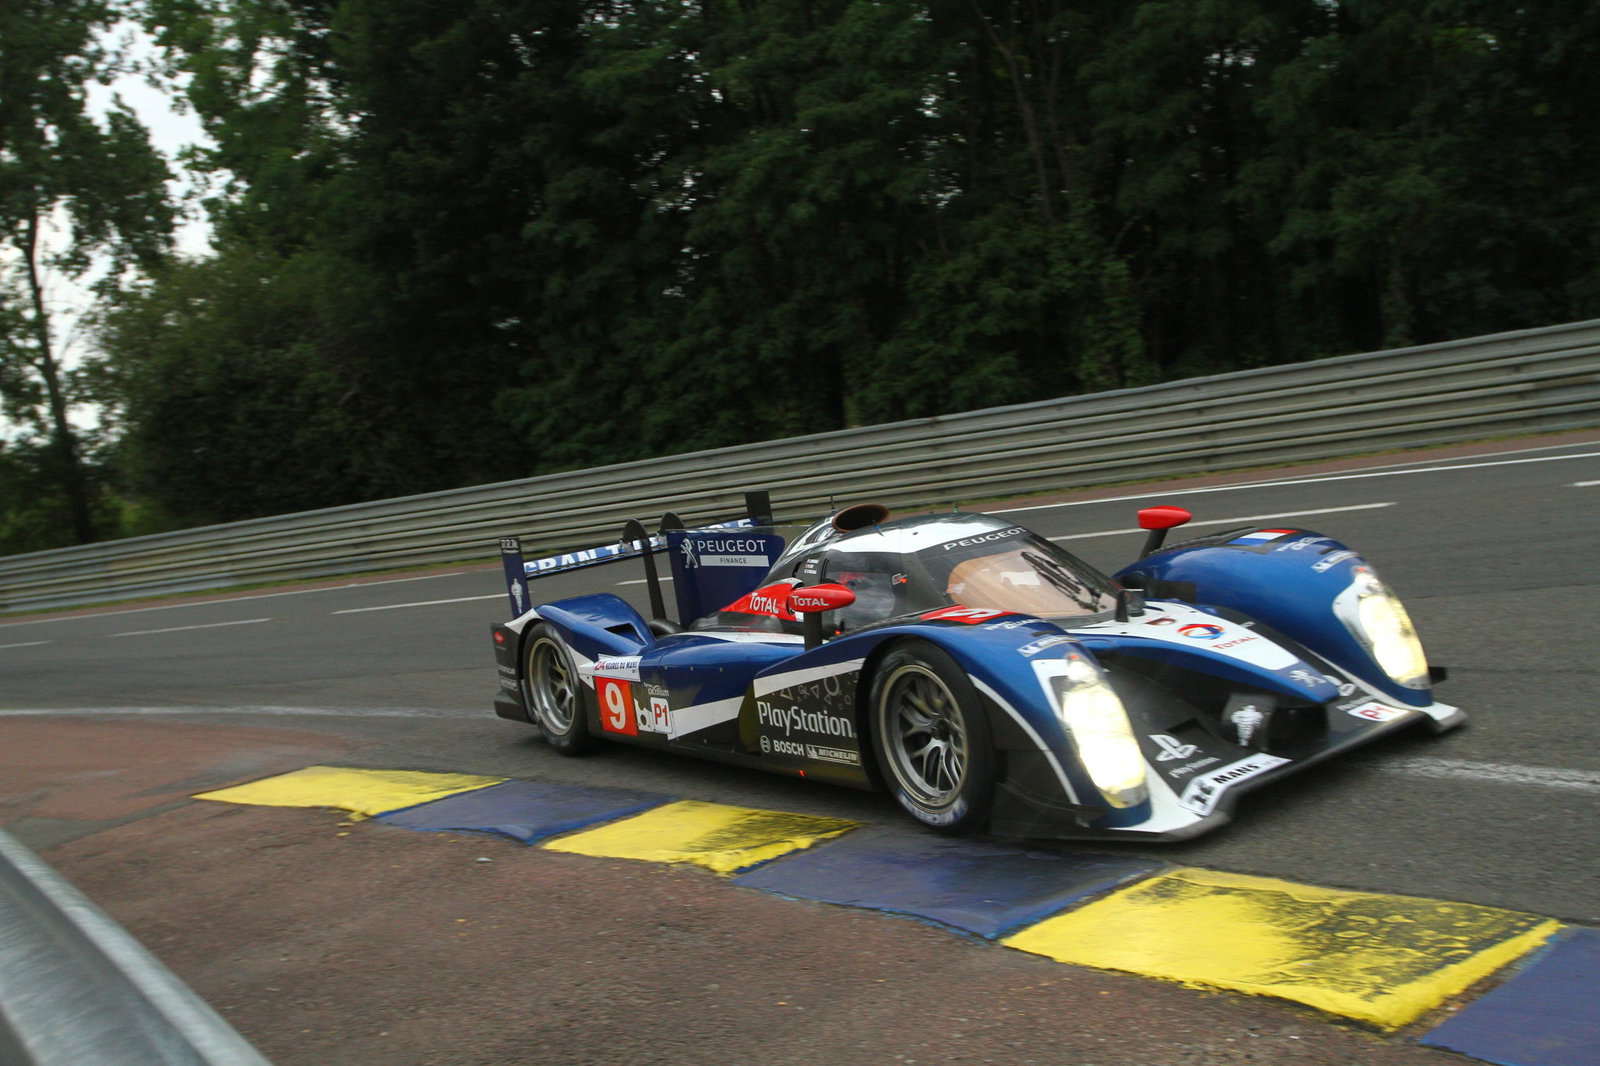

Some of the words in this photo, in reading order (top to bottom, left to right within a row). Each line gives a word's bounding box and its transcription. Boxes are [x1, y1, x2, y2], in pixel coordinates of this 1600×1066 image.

[697, 539, 766, 553] PEUGEOT
[943, 526, 1027, 551] PEUGEOT
[720, 557, 747, 565] FINANCE
[749, 592, 779, 614] TOTAL
[791, 595, 830, 607] TOTAL
[605, 682, 626, 730] 9
[654, 703, 669, 727] P1
[757, 701, 854, 738] PlayStation
[773, 739, 805, 757] BOSCH
[818, 748, 858, 761] MICHELIN
[1211, 763, 1261, 784] MANS
